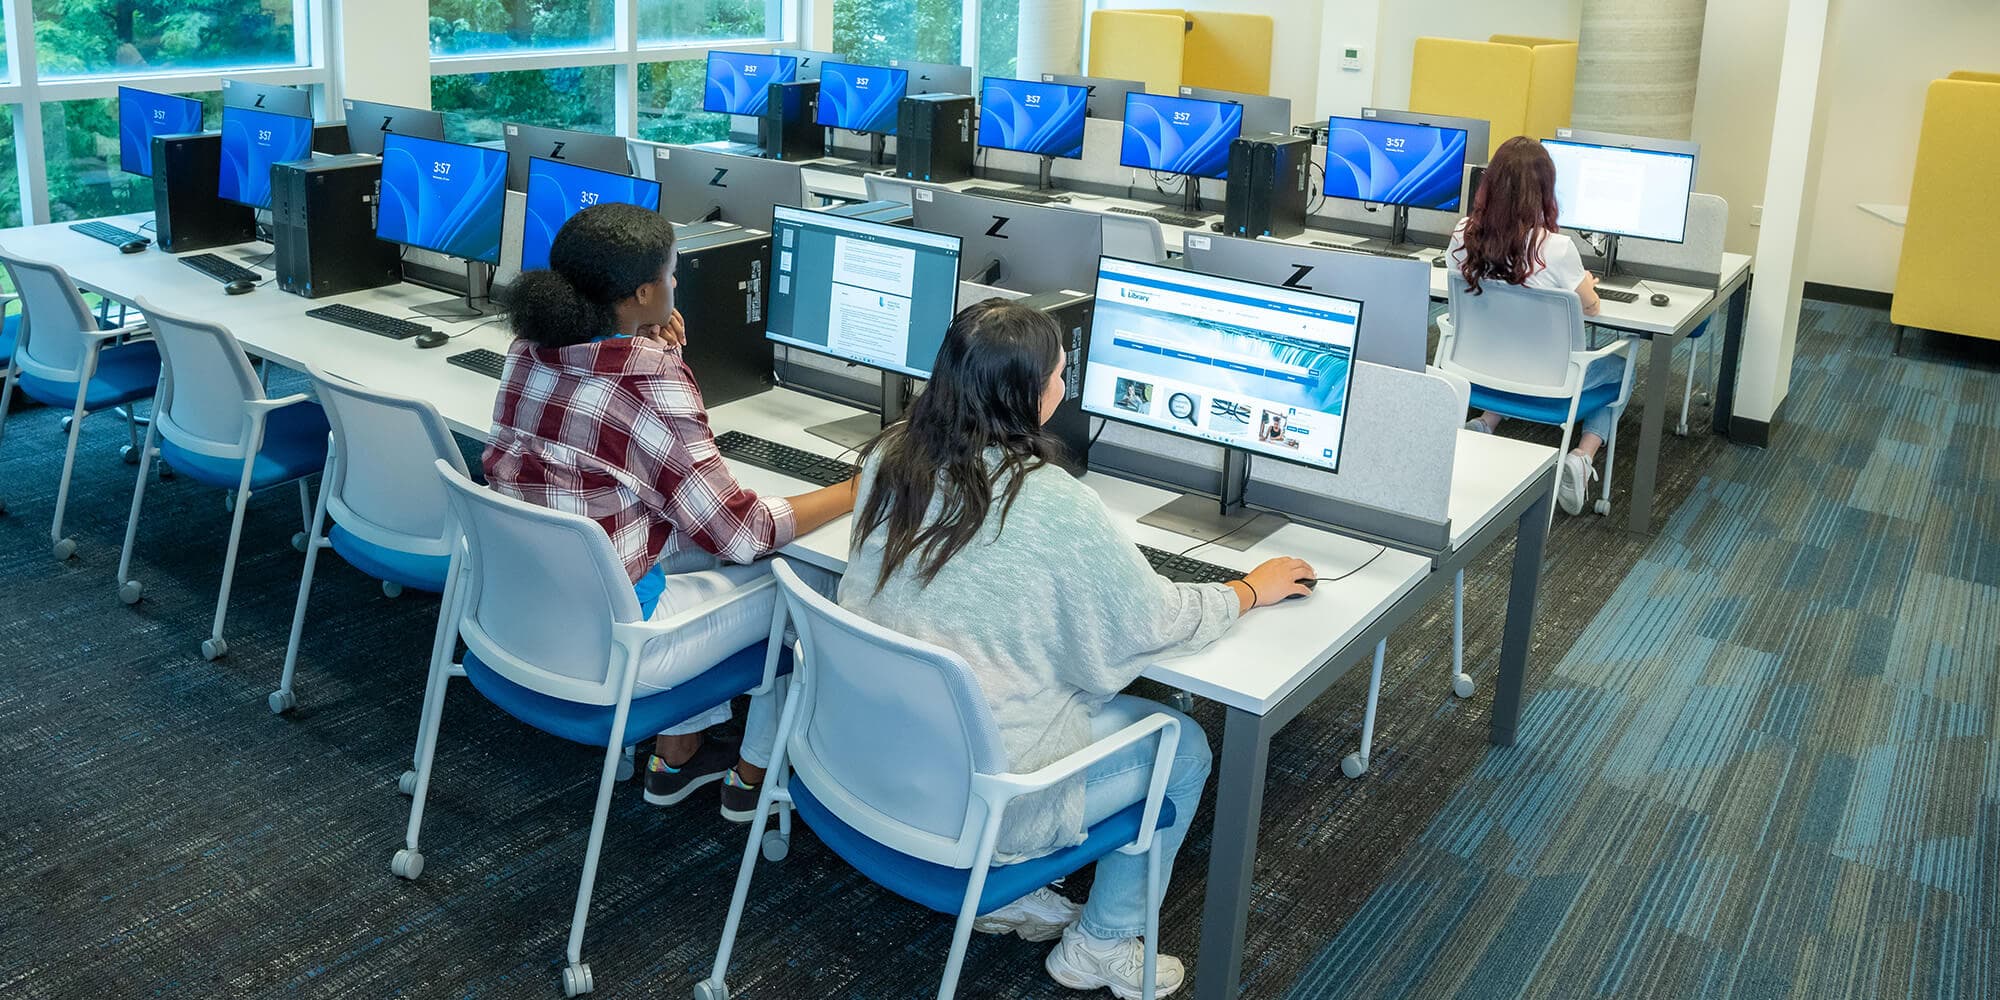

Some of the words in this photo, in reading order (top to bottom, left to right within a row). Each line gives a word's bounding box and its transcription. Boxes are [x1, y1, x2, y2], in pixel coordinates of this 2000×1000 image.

[800, 57, 810, 68] Z
[254, 93, 265, 108] Z
[1026, 94, 1040, 104] 3:57
[153, 109, 165, 120] 3:57
[1174, 111, 1190, 121] 3:57
[380, 115, 393, 132] Z
[258, 129, 272, 141] 3:57
[1386, 137, 1405, 148] 3:57
[550, 141, 566, 160] Z
[433, 161, 451, 175] 3:57
[709, 167, 728, 188] Z
[581, 190, 599, 206] 3:57
[985, 215, 1010, 239] Z
[1282, 263, 1314, 290] Z
[1127, 291, 1150, 302] Library
